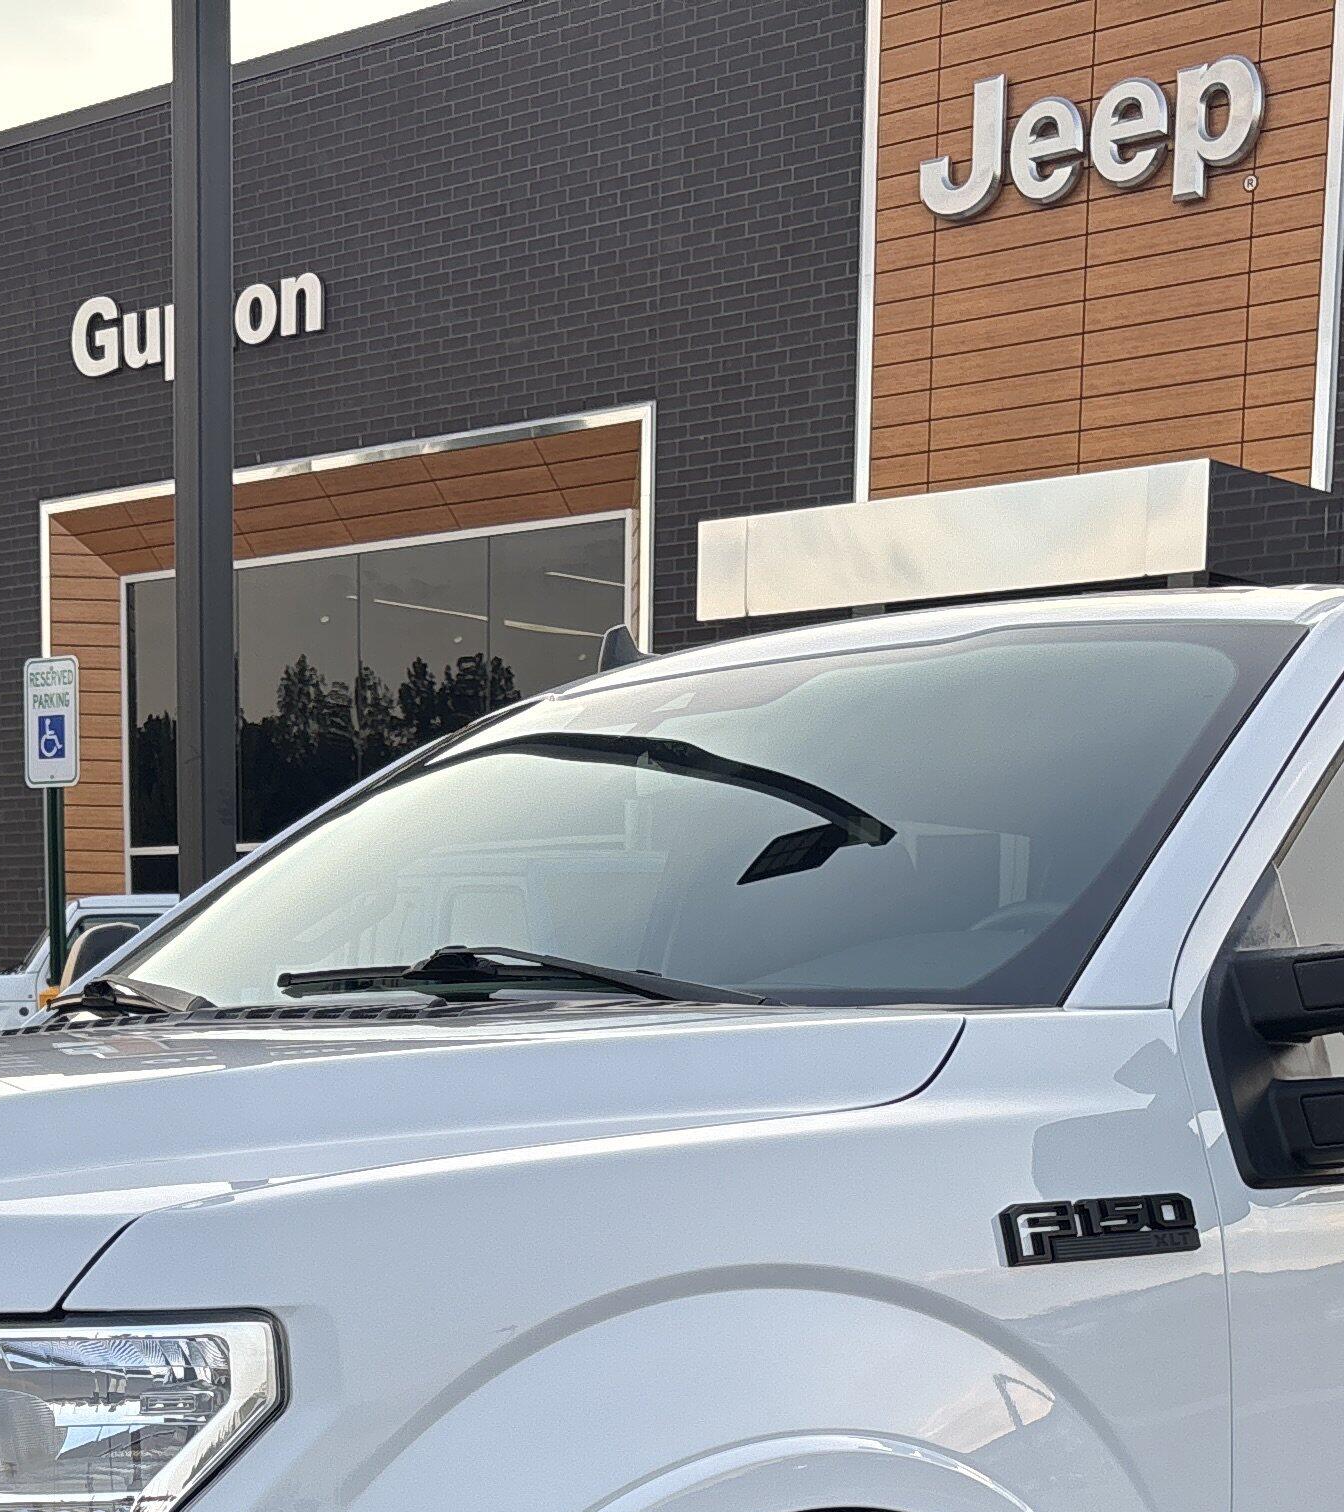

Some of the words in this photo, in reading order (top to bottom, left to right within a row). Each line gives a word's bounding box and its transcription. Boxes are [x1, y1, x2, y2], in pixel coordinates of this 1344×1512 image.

[919, 54, 1265, 221] Jeep
[71, 272, 324, 382] Guon
[29, 669, 73, 687] RESERVED
[32, 691, 70, 709] PARKING
[1154, 1231, 1192, 1248] XLT
